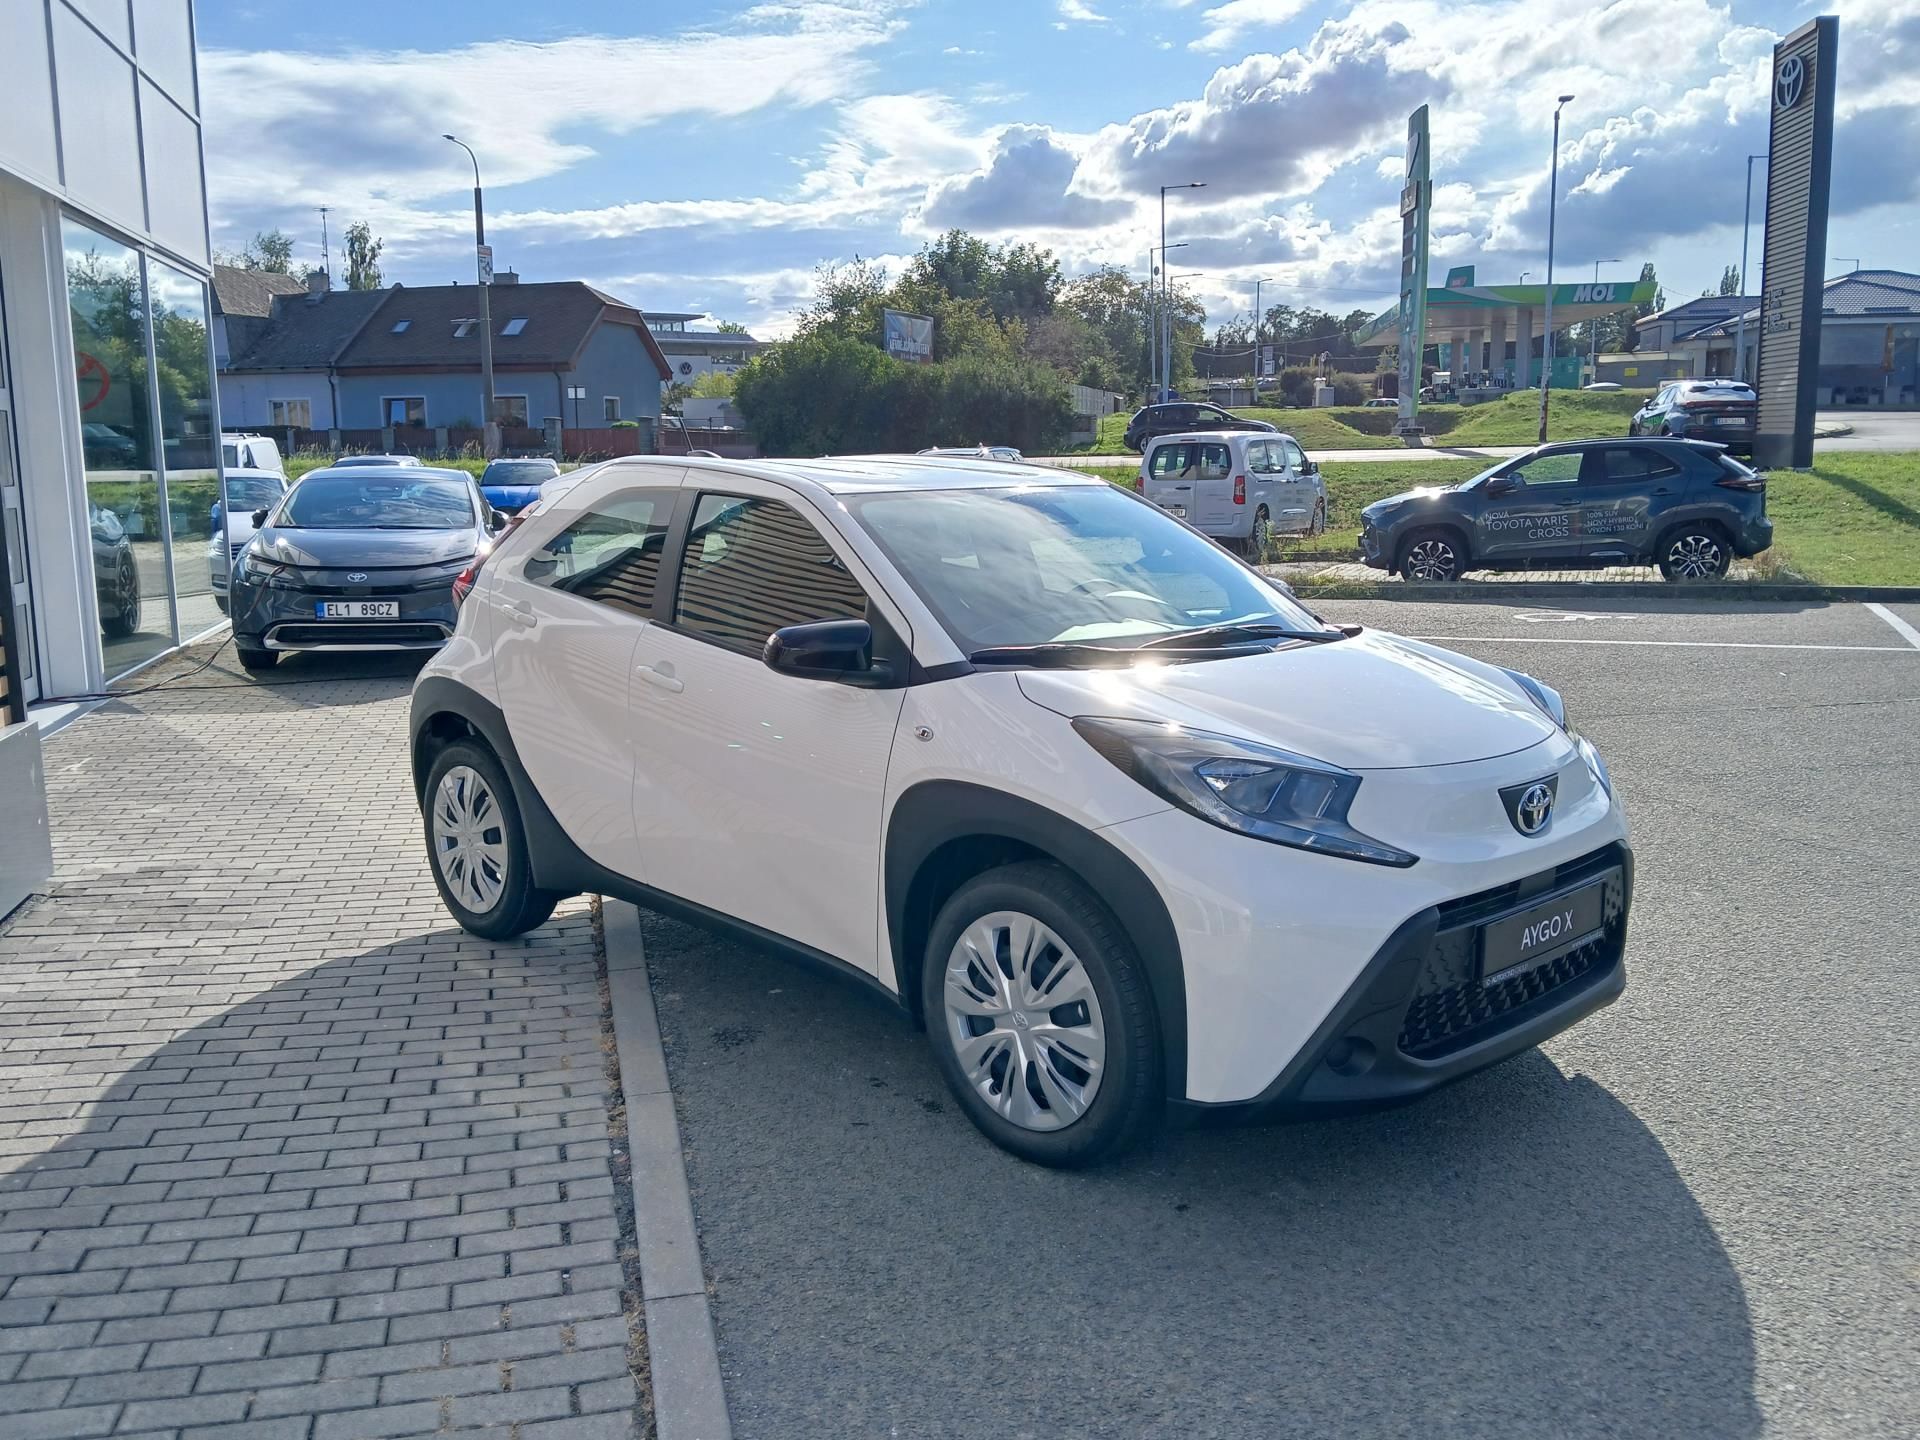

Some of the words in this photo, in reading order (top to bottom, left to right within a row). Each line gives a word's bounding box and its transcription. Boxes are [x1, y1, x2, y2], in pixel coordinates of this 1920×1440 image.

[1573, 284, 1616, 302] MOL
[1486, 518, 1533, 531] TOYOTA
[1535, 514, 1569, 526] YARIS
[1528, 526, 1569, 539] CROSS
[327, 603, 351, 617] EL1
[360, 603, 393, 616] 89CZ
[1521, 915, 1561, 950] AYGO
[1563, 909, 1573, 932] X
